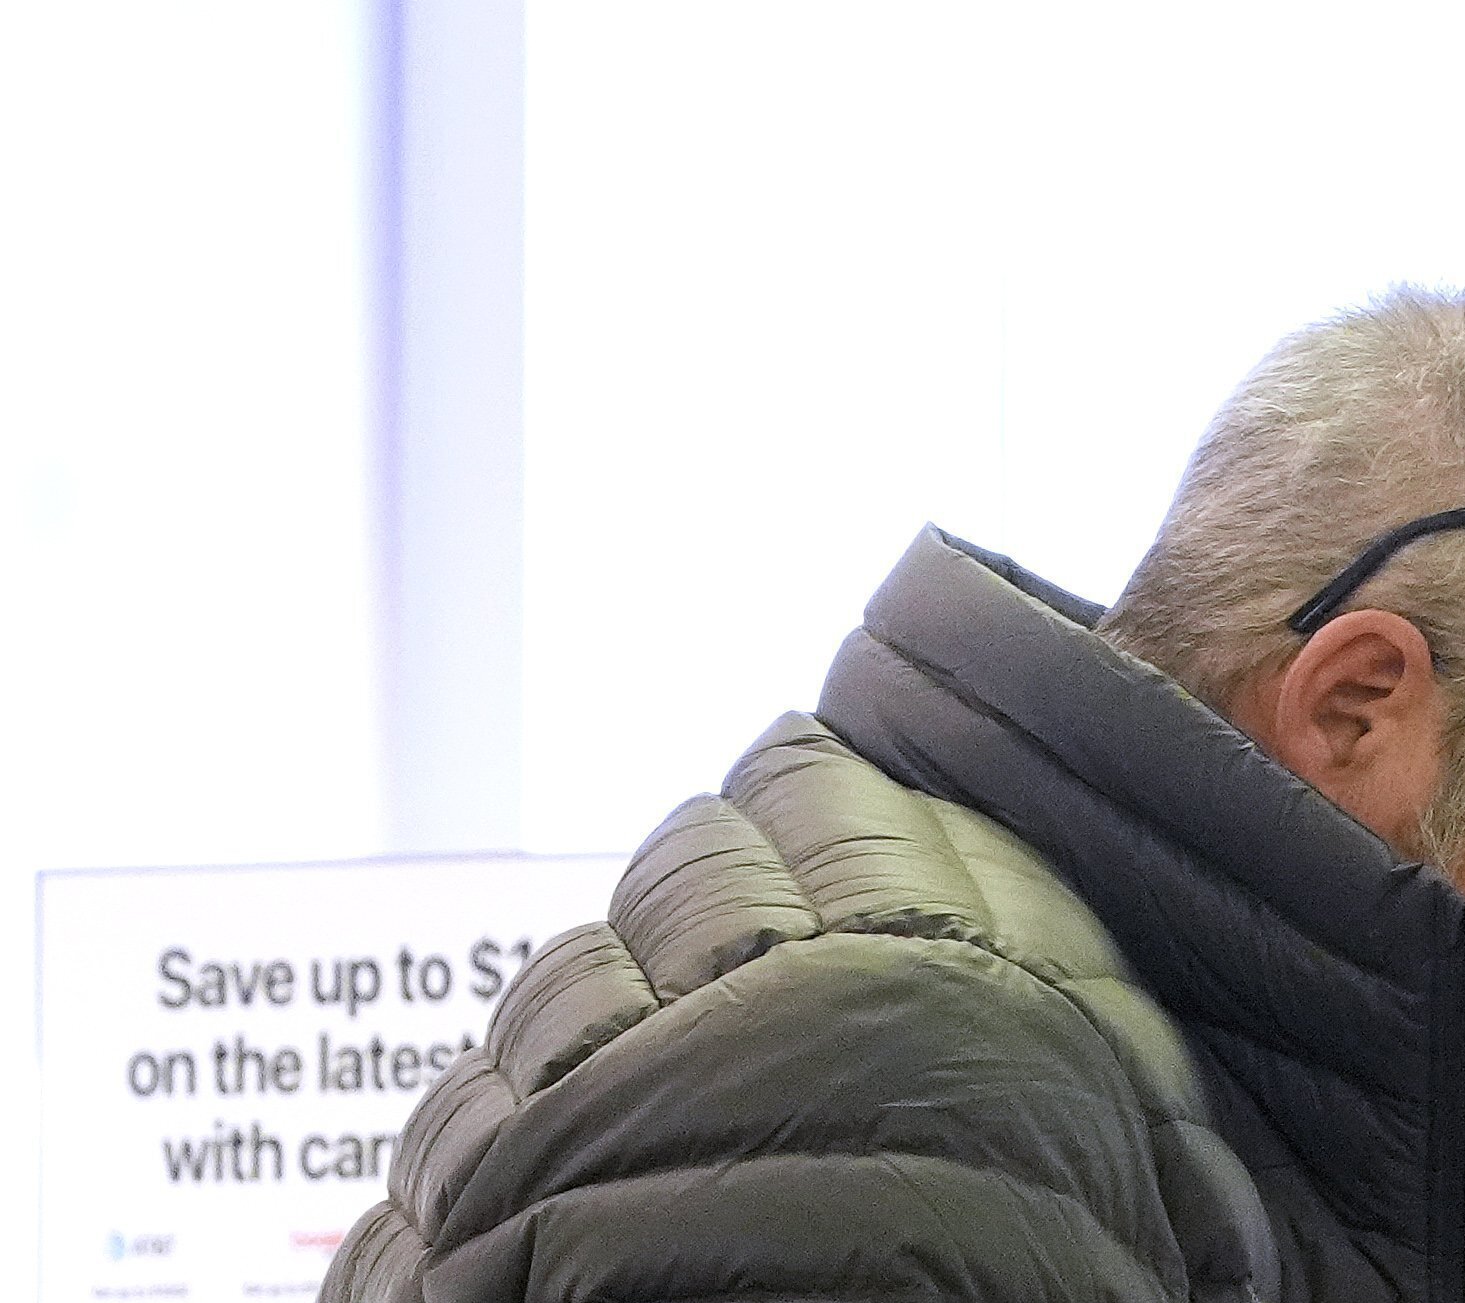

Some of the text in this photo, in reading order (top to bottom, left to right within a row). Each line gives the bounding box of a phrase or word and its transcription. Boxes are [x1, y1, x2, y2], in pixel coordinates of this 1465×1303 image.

[157, 946, 297, 1010] Save
[311, 958, 383, 1017] up
[397, 946, 454, 1003] to
[127, 1051, 196, 1097] on
[213, 1035, 303, 1095] the
[163, 1122, 283, 1183] with
